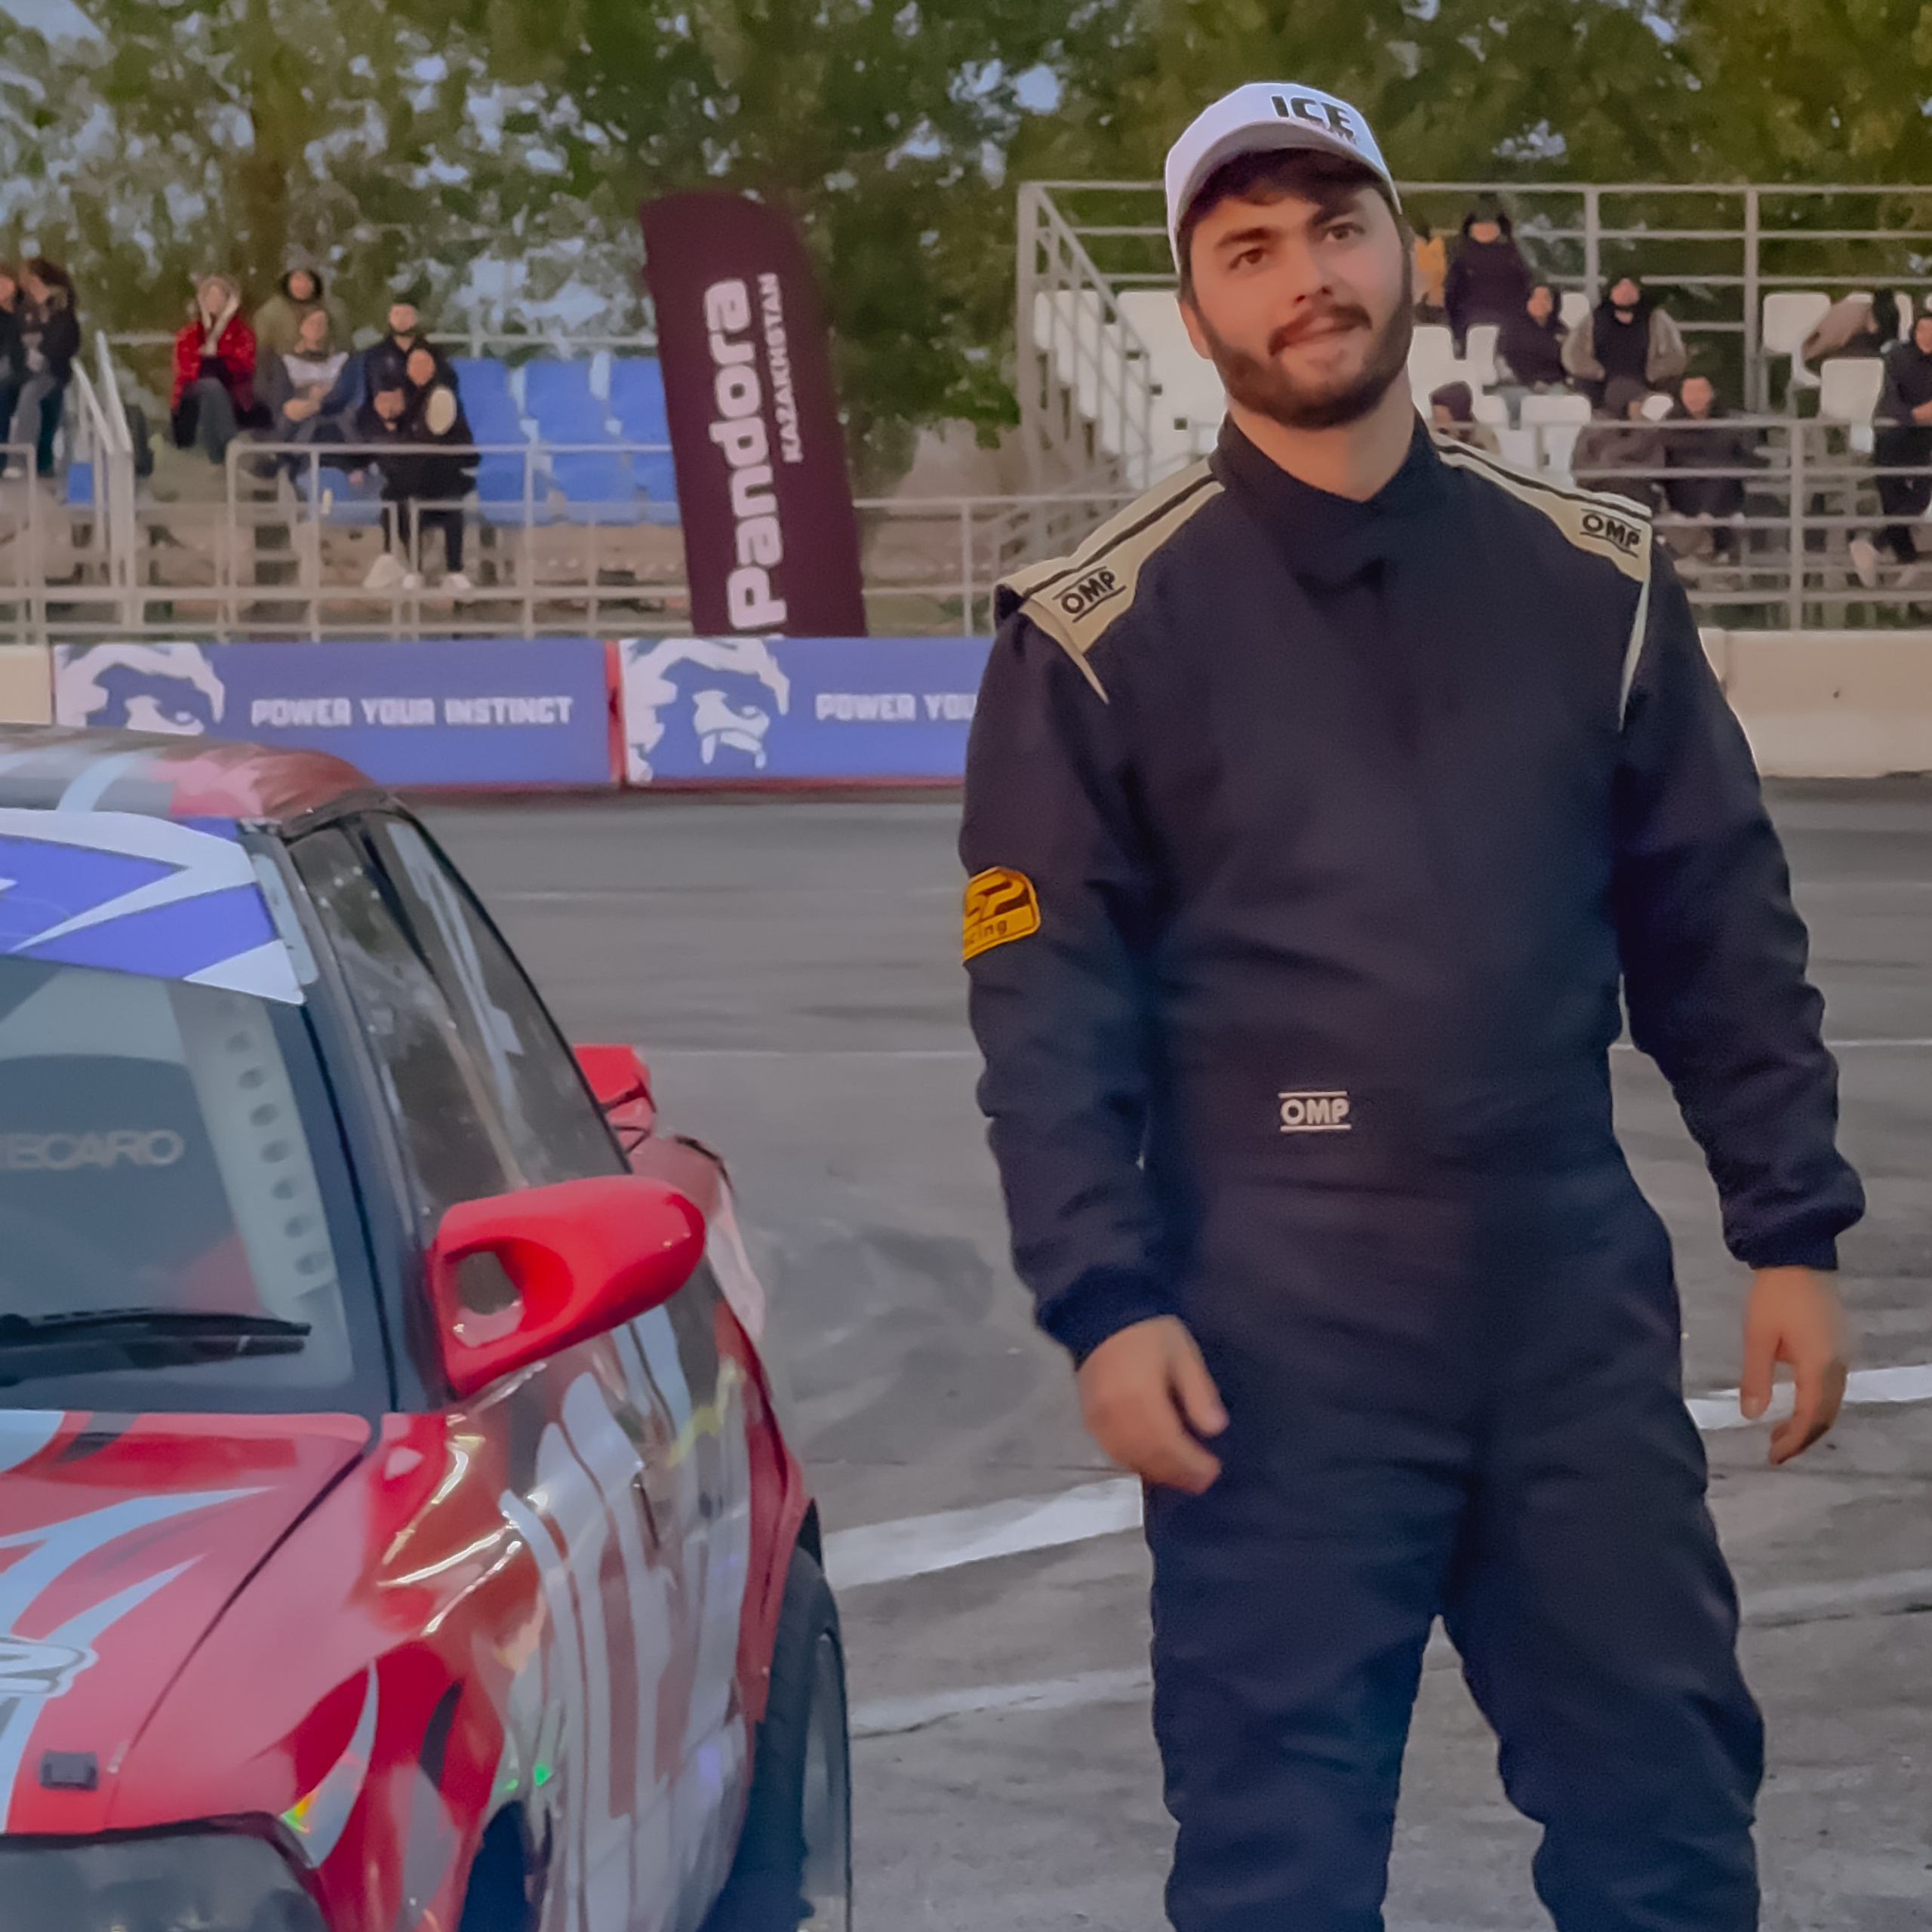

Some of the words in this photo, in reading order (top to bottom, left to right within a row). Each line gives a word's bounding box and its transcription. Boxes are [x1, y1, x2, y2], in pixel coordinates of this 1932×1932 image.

[1271, 95, 1356, 139] ICE
[703, 277, 788, 629] Pandora
[1582, 512, 1641, 549] OMP
[1060, 568, 1117, 615] OMP
[251, 697, 352, 727] POWER
[360, 697, 435, 725] YOUR
[444, 696, 574, 725] INSTINCT
[814, 693, 916, 722] POWER
[921, 693, 980, 721] YOU
[1280, 1097, 1350, 1125] OMP
[0, 1129, 186, 1171] ECARO
